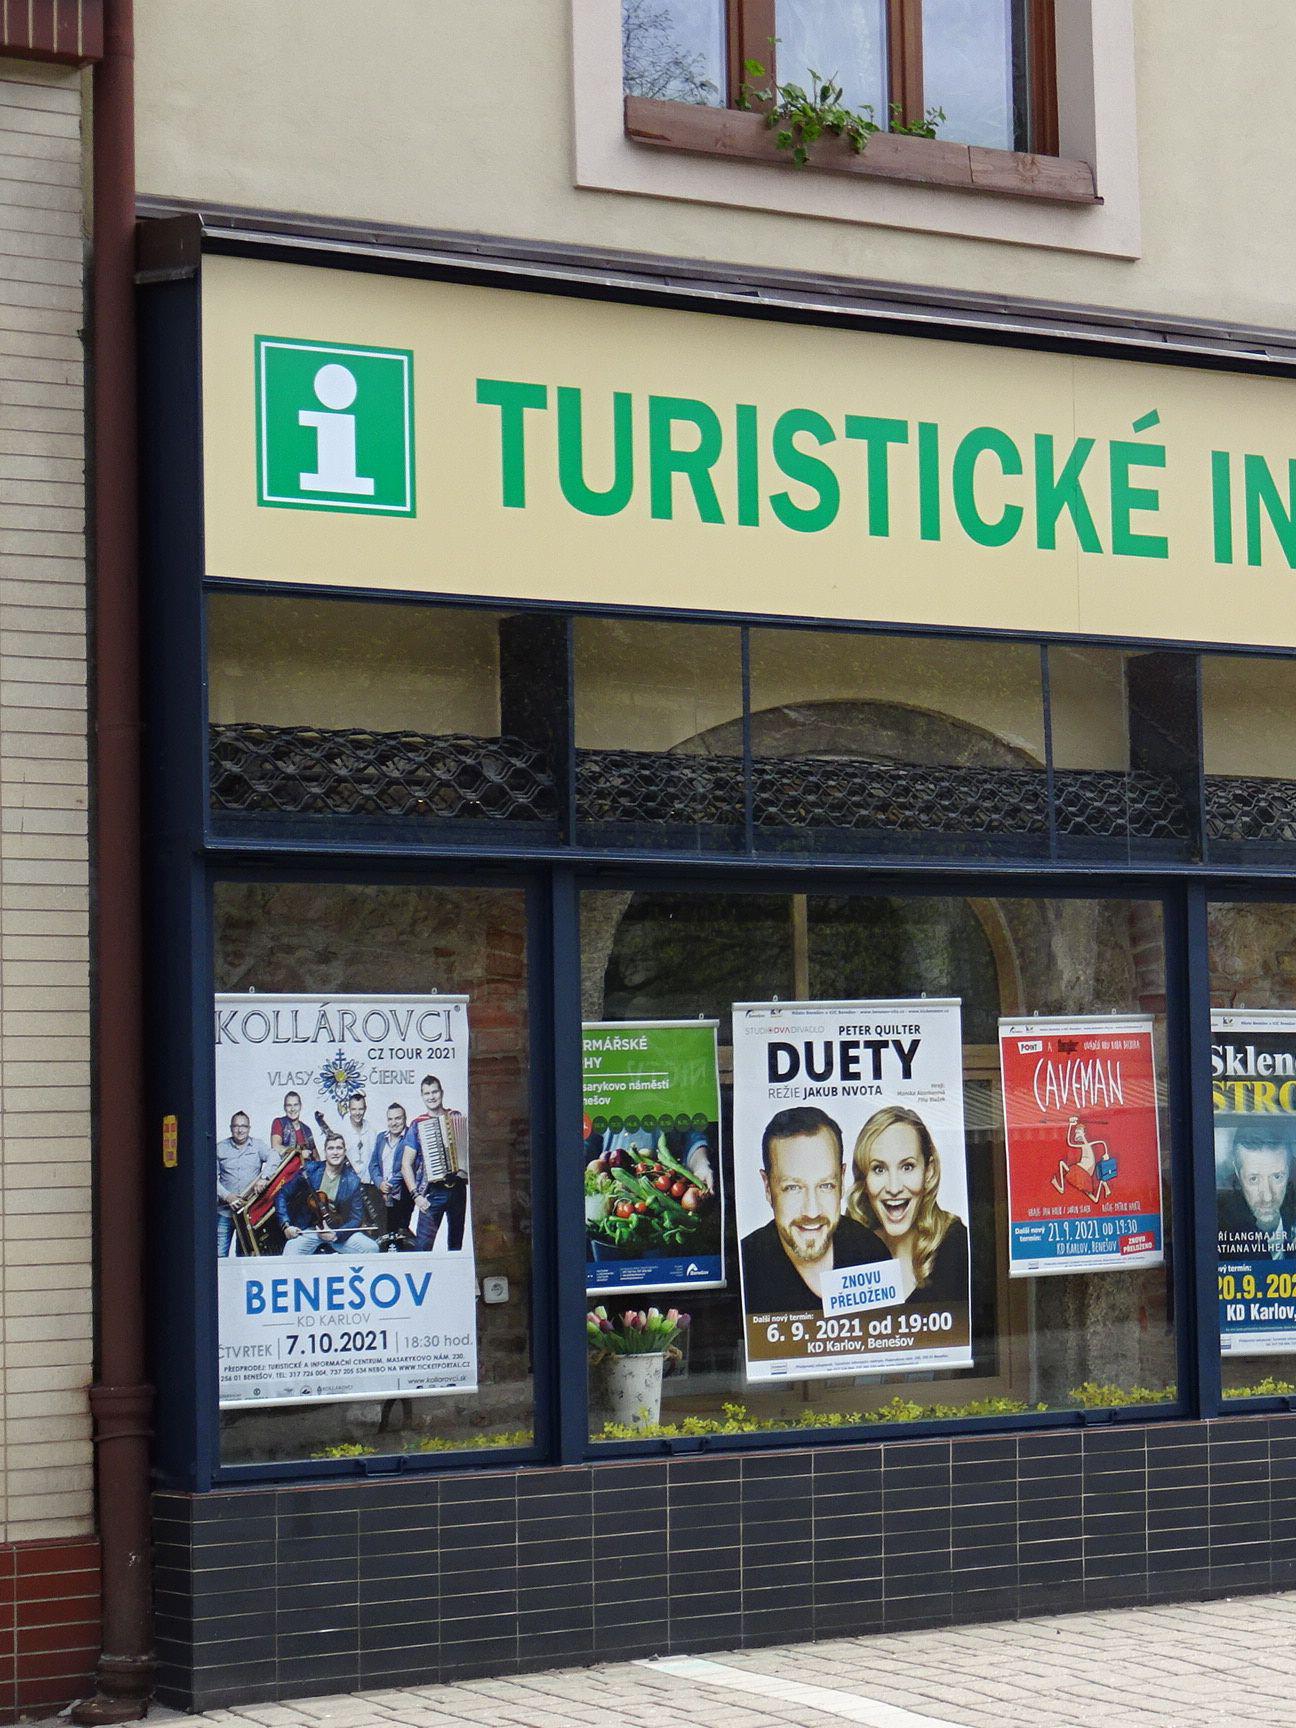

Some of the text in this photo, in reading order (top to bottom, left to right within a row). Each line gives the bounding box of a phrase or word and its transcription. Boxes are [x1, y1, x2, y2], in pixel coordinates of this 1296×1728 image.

[476, 379, 1169, 559] TURISTICKÉ
[215, 1002, 455, 1045] KOLLÁROVCI
[838, 1024, 921, 1037] PETER QUILTER
[583, 1035, 648, 1051] RMÁŘSKÉ
[367, 1047, 456, 1060] CZ TOUR 2021
[768, 1039, 921, 1083] DUETY
[584, 1057, 602, 1069] HY
[268, 1067, 415, 1087] VLASY ČIERNE
[583, 1079, 669, 1093] sarykovo náměstí
[1034, 1057, 1124, 1113] CAVEMAN
[583, 1095, 611, 1106] nešov
[768, 1085, 883, 1100] REŽIE JAKUB NVOTA
[1102, 1222, 1113, 1236] OD
[1115, 1218, 1138, 1236] 19:30
[1218, 1230, 1288, 1242] ŘÍ LANGMAJER
[1056, 1243, 1066, 1255] KD
[1091, 1239, 1117, 1254] BENEŠOV
[1217, 1243, 1250, 1254] ATIANA
[841, 1269, 882, 1290] ZNOVU
[246, 1266, 433, 1315] BENEŠOV
[830, 1285, 897, 1310] PŘELOŽENO
[297, 1313, 371, 1328] KD KARLOV
[771, 1313, 789, 1324] nový
[789, 1312, 814, 1322] termín:
[1226, 1304, 1245, 1322] KD
[766, 1312, 952, 1343] 6. 9. 2021 od 19:00
[218, 1330, 473, 1360] ČTVRTEK 7.10.2021 18:30 hod.
[807, 1335, 915, 1353] KD Karlov, Benešov
